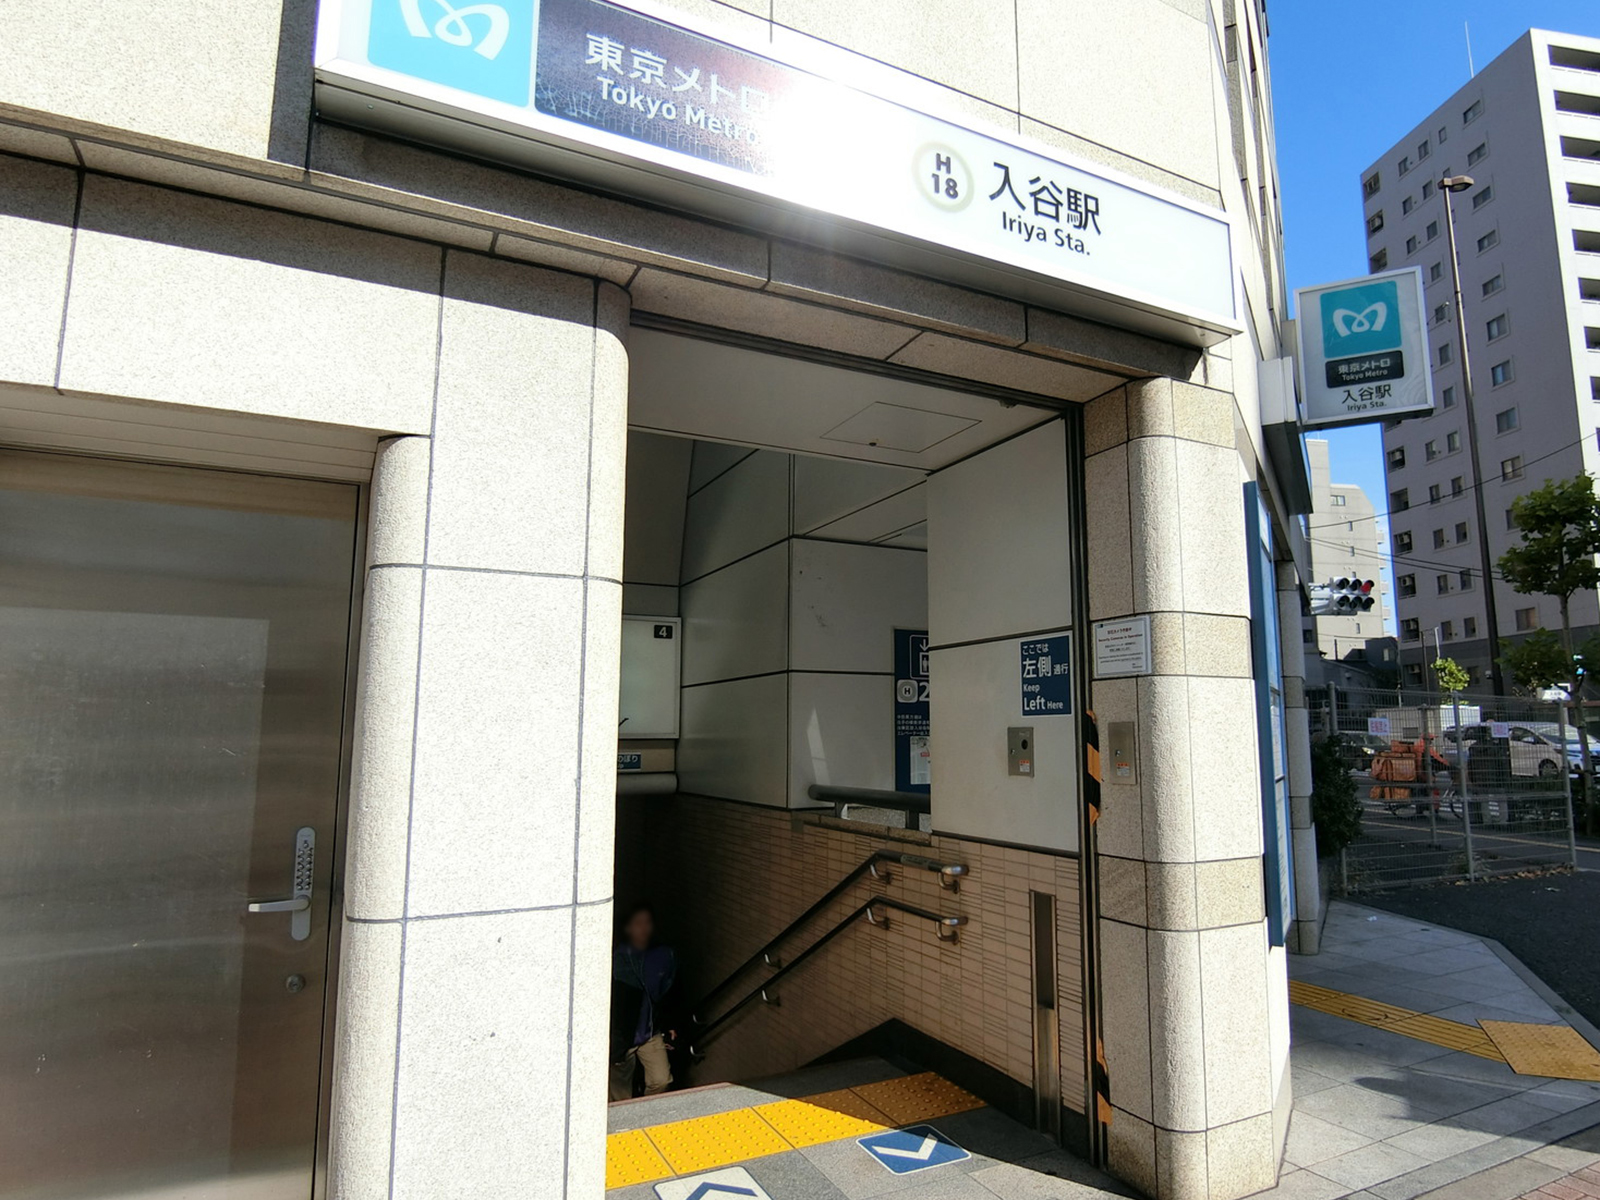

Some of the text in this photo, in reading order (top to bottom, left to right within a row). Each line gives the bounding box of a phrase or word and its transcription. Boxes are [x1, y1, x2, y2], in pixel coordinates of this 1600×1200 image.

[585, 32, 770, 115] 東京メトロ
[597, 77, 760, 145] Tokyo Metro
[936, 153, 951, 174] H
[931, 173, 959, 200] 18
[988, 161, 1102, 236] 入谷駅
[1002, 211, 1091, 256] Iriya Sta.
[1338, 358, 1391, 375] 東京メトロ
[1342, 369, 1388, 381] Tokyo Metro
[1342, 384, 1392, 404] 入谷駅
[1347, 403, 1367, 412] Iriya
[659, 627, 667, 637] 4
[1022, 643, 1049, 655] ここでは
[904, 687, 911, 695] H
[1023, 684, 1040, 693] Keep
[1024, 696, 1064, 711] Left Here
